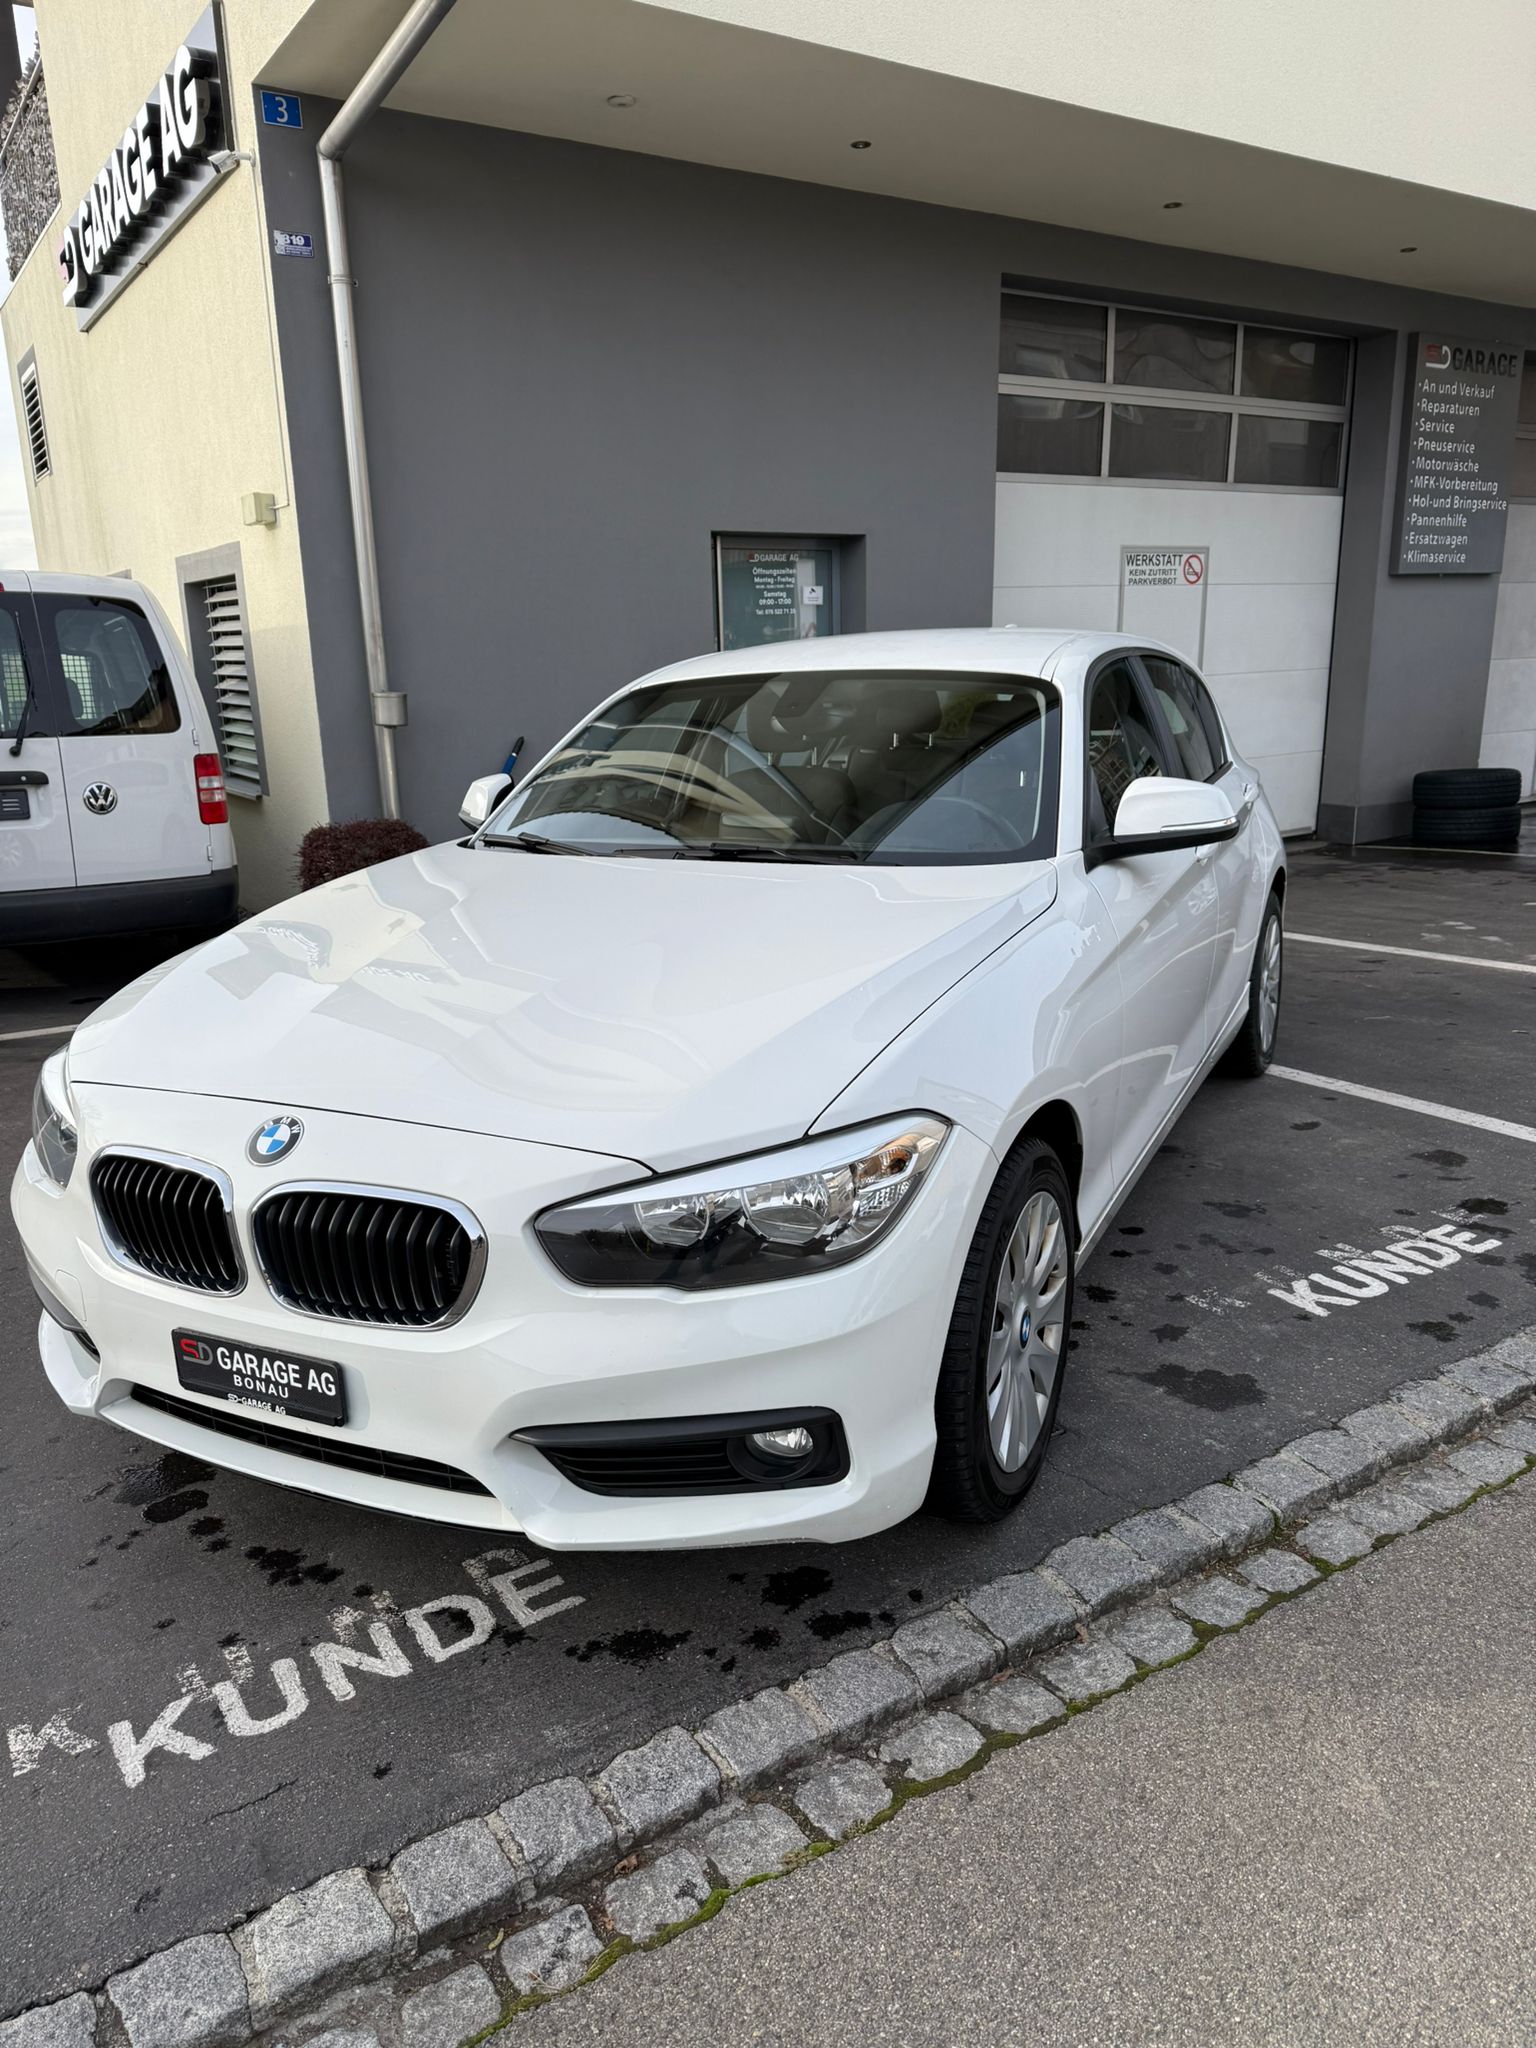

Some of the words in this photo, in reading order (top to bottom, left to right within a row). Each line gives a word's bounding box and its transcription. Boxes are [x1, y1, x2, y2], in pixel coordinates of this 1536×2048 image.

[274, 96, 289, 123] 3
[78, 102, 157, 275] GARAGE
[159, 44, 200, 177] AG
[1452, 347, 1518, 378] GARAGE
[1422, 378, 1436, 393] An
[1438, 381, 1457, 395] und
[1459, 382, 1496, 399] Verkauf
[1421, 398, 1480, 416] Reparaturen
[1419, 417, 1455, 433] Service
[1417, 436, 1476, 454] Pneuservice
[1415, 456, 1480, 472] Motorwäsche
[1414, 475, 1499, 495] MFK-Vorbereitung
[1453, 495, 1507, 512] Bringservice
[1411, 512, 1467, 527] Pannenhilfe
[1409, 531, 1468, 548] Ersatzwagen
[760, 553, 787, 562] GARAGE
[789, 553, 799, 561] AG
[1126, 554, 1184, 567] WERKSTATT
[1407, 550, 1466, 563] Klimaservice
[752, 566, 797, 576] Öffnungszeiten
[1129, 568, 1146, 576] KEIN
[1148, 568, 1178, 576] ZUTRITT
[754, 576, 774, 584] Montag
[777, 576, 796, 584] Freitag
[1128, 577, 1178, 585] PARKVERBOT
[763, 590, 787, 598] Samstag
[1267, 1223, 1503, 1317] KUNDE
[180, 1337, 214, 1366] SD
[216, 1346, 303, 1388] GARAGE
[307, 1368, 337, 1397] AG
[233, 1373, 289, 1399] BONAU
[227, 1392, 272, 1412] SD-GARAGE
[275, 1406, 287, 1415] AG
[107, 1557, 587, 1789] KUNDE
